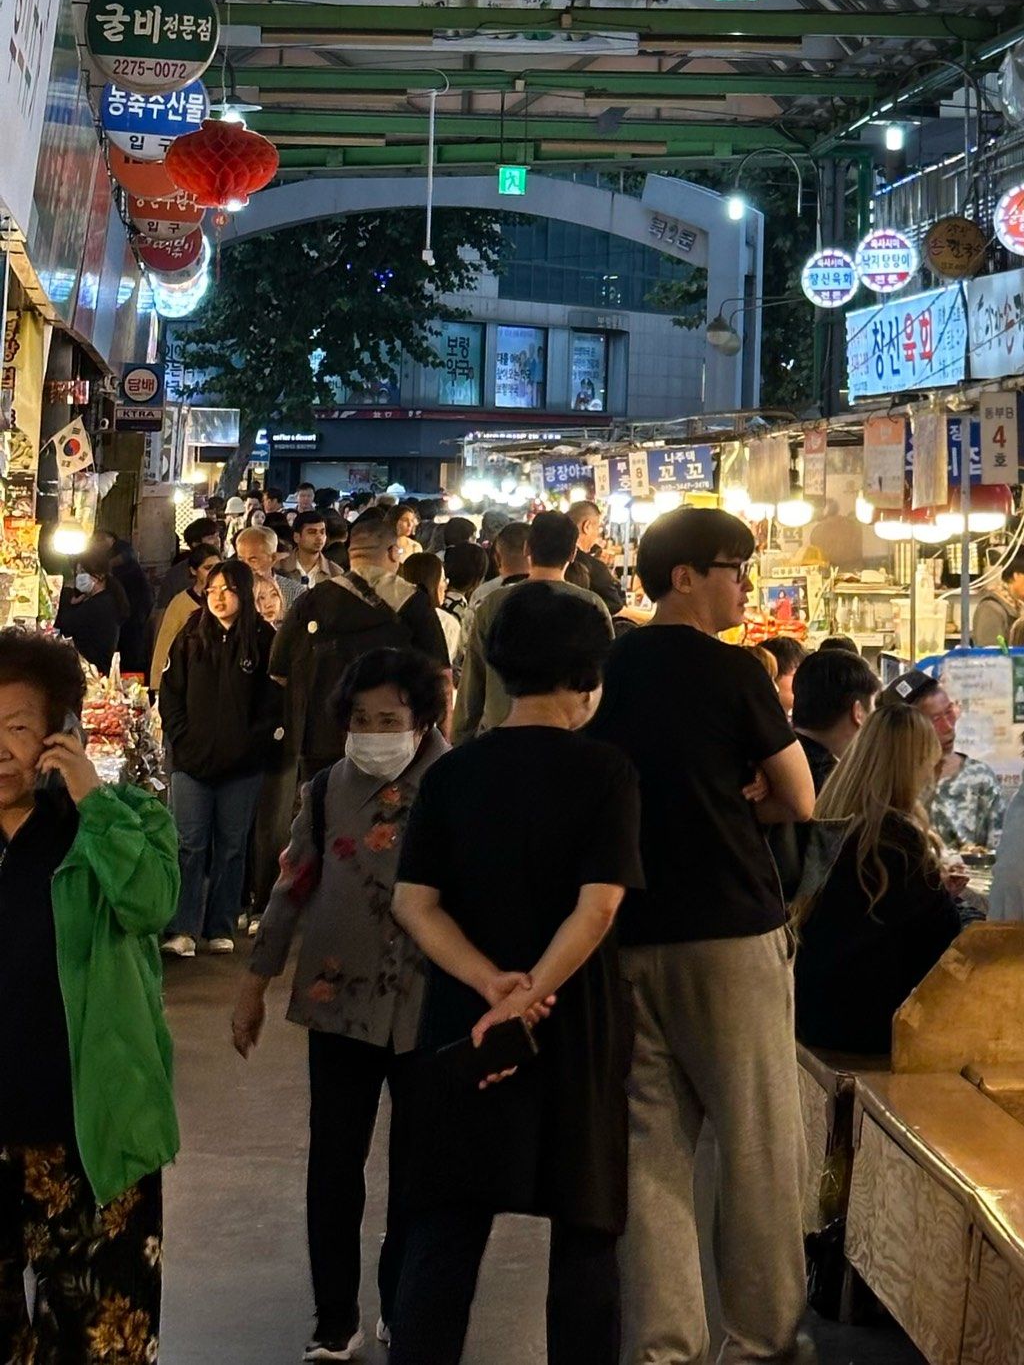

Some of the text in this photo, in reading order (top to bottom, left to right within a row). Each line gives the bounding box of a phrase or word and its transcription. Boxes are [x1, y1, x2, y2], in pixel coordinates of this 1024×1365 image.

[96, 3, 212, 44] 굴비전문점
[113, 59, 187, 79] 2275-0072
[108, 84, 204, 124] 농축수산물
[872, 307, 934, 381] 창신육회
[128, 378, 155, 392] 담배
[985, 406, 1015, 420] 동부B
[992, 425, 1007, 448] 4
[994, 454, 1008, 467] 호
